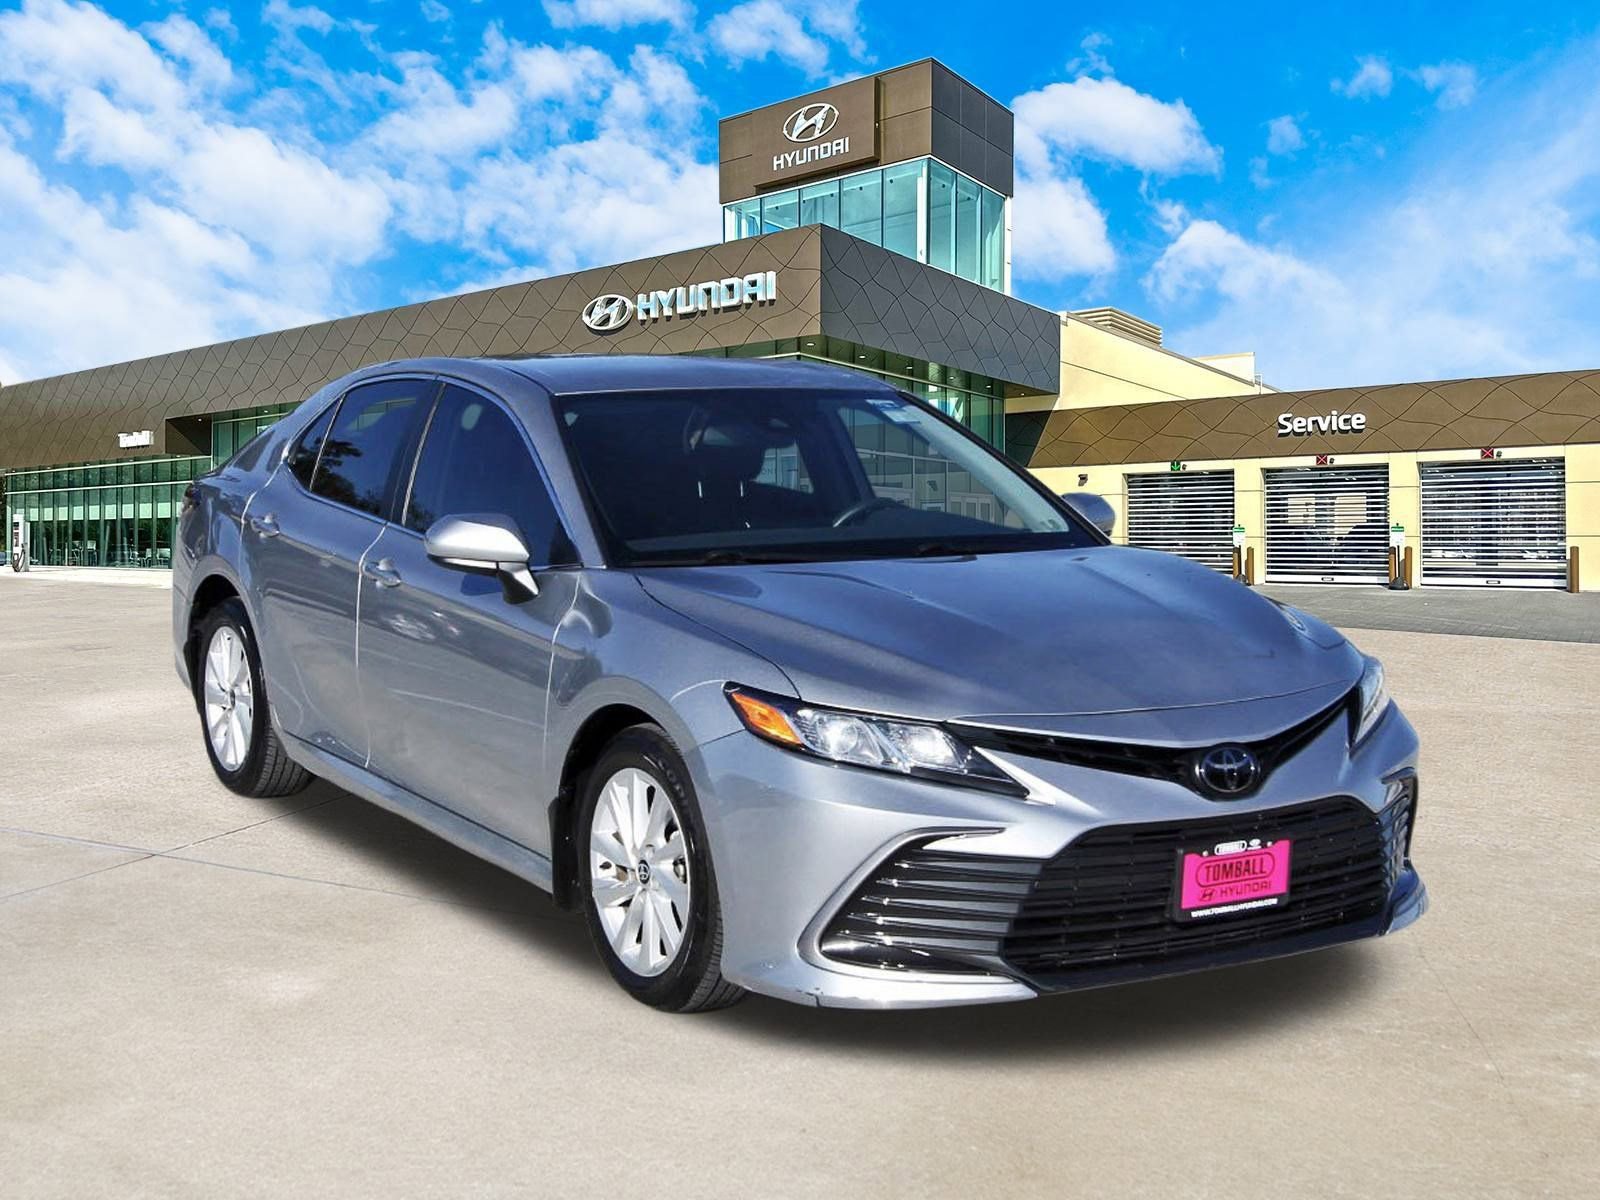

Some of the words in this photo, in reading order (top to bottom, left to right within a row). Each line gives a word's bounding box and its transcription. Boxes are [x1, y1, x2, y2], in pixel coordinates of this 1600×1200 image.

[773, 137, 849, 171] HYUNDAI
[637, 271, 777, 321] HYUNDAI
[1278, 410, 1366, 434] Service
[1205, 859, 1267, 883] TOMBALL
[1220, 880, 1272, 897] HYUNDAI
